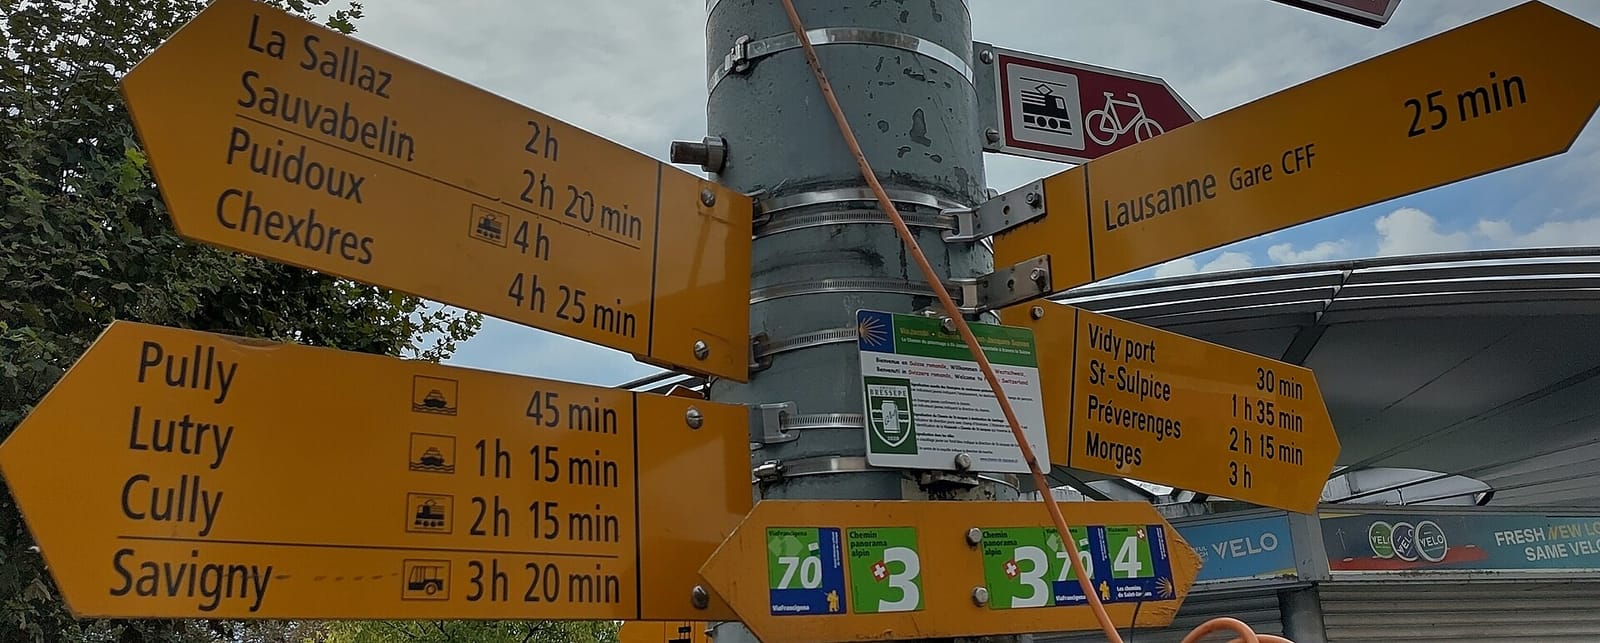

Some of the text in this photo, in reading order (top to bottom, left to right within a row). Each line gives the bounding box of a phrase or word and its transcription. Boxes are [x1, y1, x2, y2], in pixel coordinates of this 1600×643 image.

[248, 14, 286, 60] La
[300, 35, 392, 99] Sallaz
[225, 127, 366, 205] Puidoux
[237, 71, 415, 162] Sauvabelin
[564, 184, 595, 224] 20
[600, 204, 643, 242] min
[1104, 71, 1528, 232] Lausanne Gare CFF 25 min
[216, 187, 375, 266] Chexbres
[556, 284, 587, 325] 25
[593, 298, 636, 339] min
[136, 340, 618, 435] Pully 45 min
[1087, 322, 1303, 401] Vidy port 30 min
[1088, 360, 1172, 403] St-Sulpice
[1256, 399, 1275, 426] 35
[1279, 409, 1303, 433] min
[128, 405, 235, 470] Lutry
[529, 444, 560, 484] 15
[568, 449, 619, 488] min
[1086, 394, 1182, 443] Préverenges
[1260, 434, 1275, 459] 15
[1279, 442, 1303, 466] min
[1086, 431, 1143, 469] Morges
[119, 474, 224, 538] Cully
[528, 501, 560, 540] 15
[568, 503, 620, 543] min
[849, 531, 877, 539] Chemin
[850, 541, 888, 549] panorama
[851, 550, 870, 559] alpin
[983, 531, 1008, 539] Chemin
[983, 540, 1018, 548] panorama
[985, 548, 1002, 557] alpin
[1113, 536, 1142, 579] 4
[1211, 532, 1278, 559] VELO
[1419, 535, 1444, 547] VELO
[1494, 527, 1546, 546] FRESH
[1548, 524, 1583, 541] NEW
[1525, 541, 1569, 562] SAME
[109, 548, 273, 612] Savigny
[523, 562, 560, 604] 20
[568, 563, 621, 604] min
[777, 555, 823, 590] 70
[878, 546, 920, 613] 3
[1011, 546, 1049, 608] 3
[1056, 550, 1093, 582] 70
